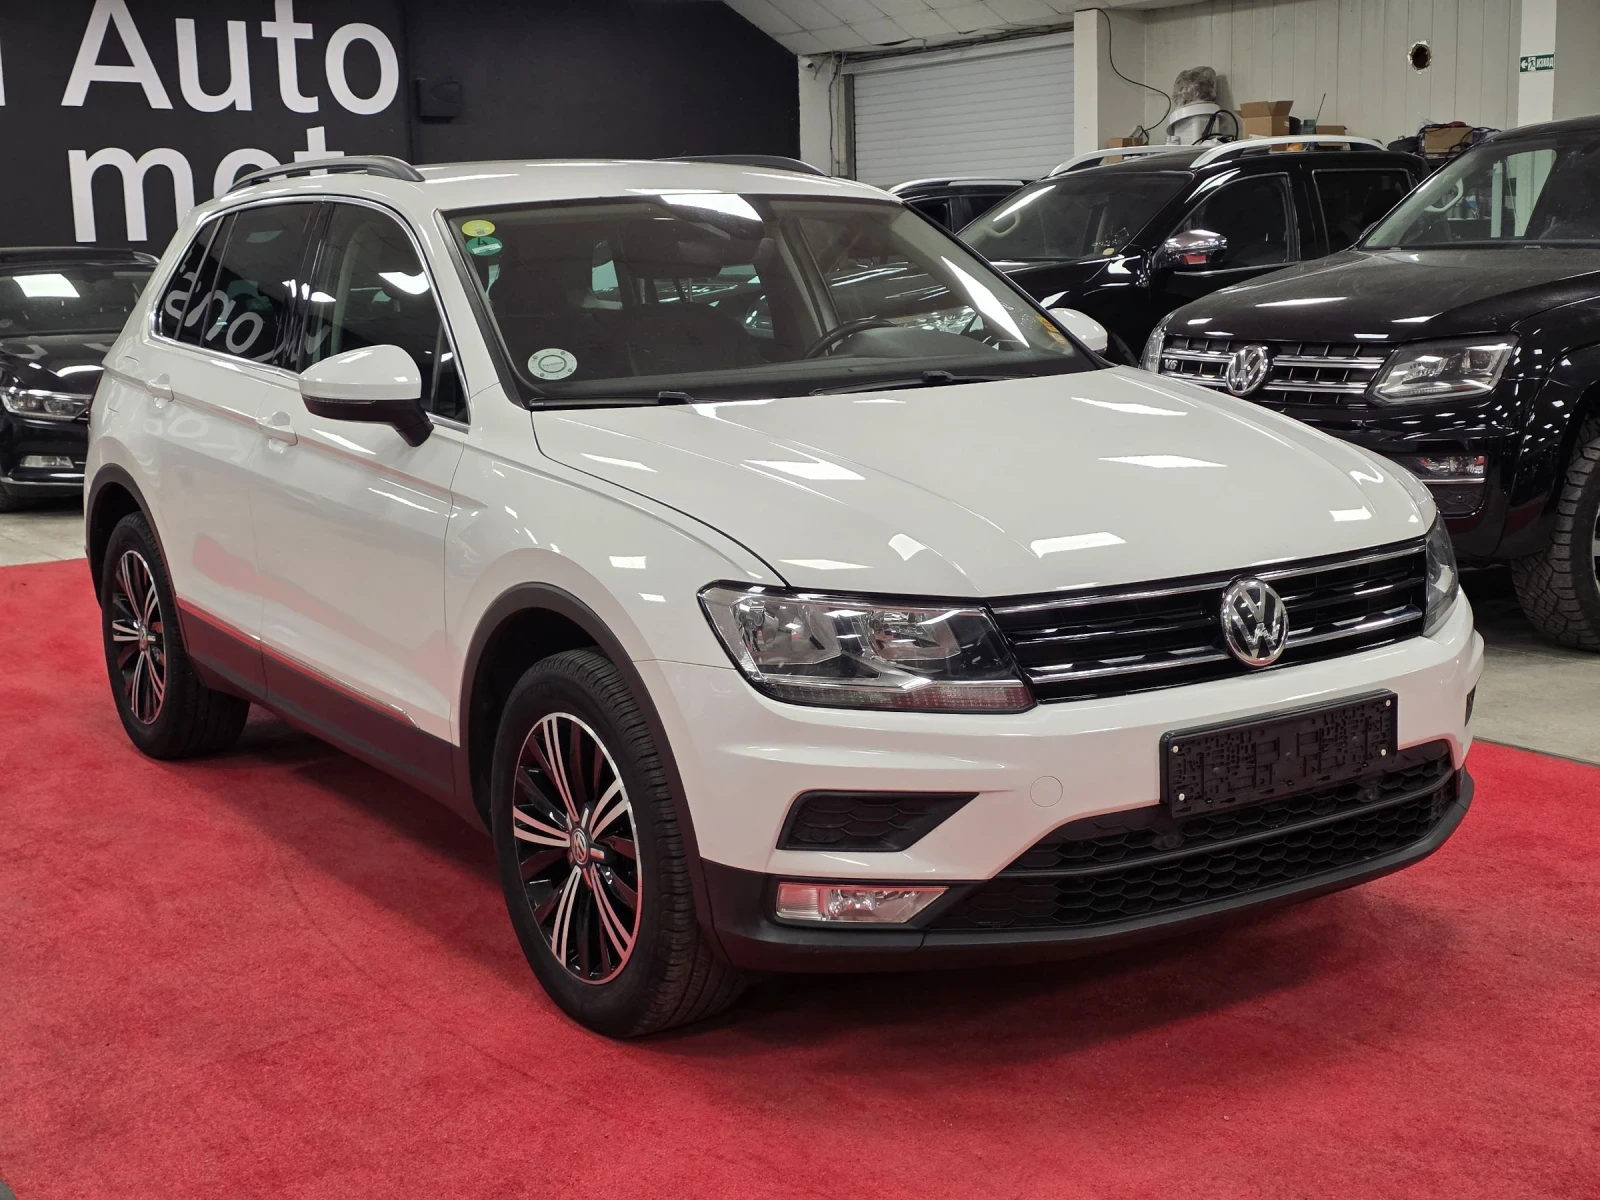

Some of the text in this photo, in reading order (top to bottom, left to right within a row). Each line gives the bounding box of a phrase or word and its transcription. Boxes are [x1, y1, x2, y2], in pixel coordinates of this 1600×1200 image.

[60, 0, 399, 115] Auto
[1164, 359, 1178, 370] V6
[1221, 577, 1289, 666] VW
